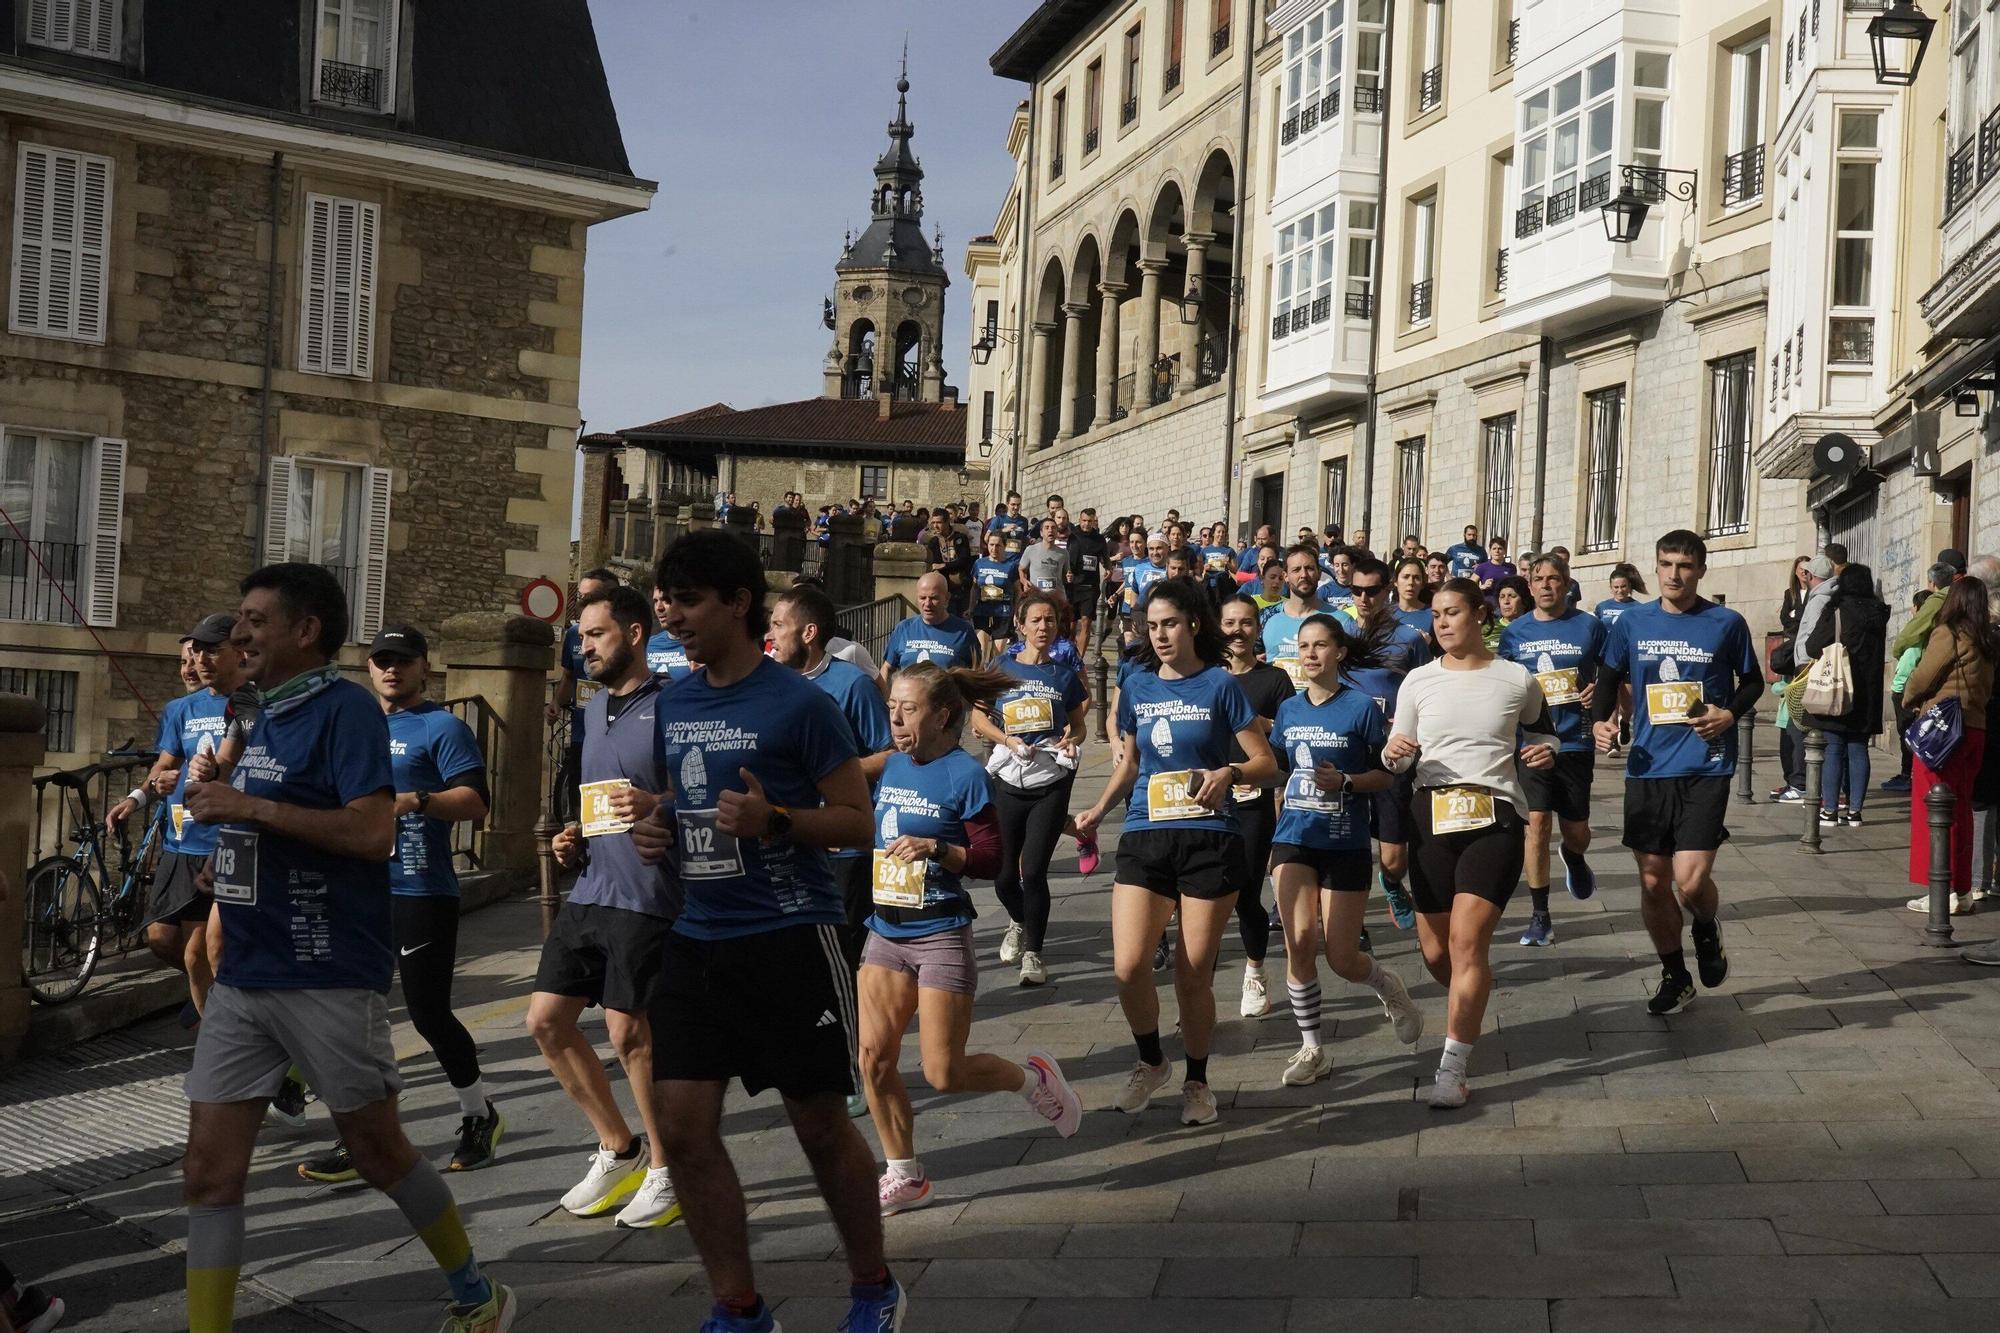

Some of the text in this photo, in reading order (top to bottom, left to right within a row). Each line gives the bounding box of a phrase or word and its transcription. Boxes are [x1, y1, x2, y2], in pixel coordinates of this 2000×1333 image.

[1942, 494, 1948, 504] 2
[1527, 643, 1574, 653] ALMENDRA
[1647, 647, 1704, 656] ALMENDRA
[1676, 655, 1712, 663] KONKISTA
[1545, 678, 1568, 692] 326
[1140, 700, 1184, 710] CONQUISTA
[1662, 692, 1687, 708] 672
[1016, 705, 1040, 720] 640
[1144, 704, 1198, 718] ALMENDRA
[1170, 713, 1211, 722] KONKISTA
[190, 720, 226, 732] ALMEND
[672, 720, 726, 732] CONQUISTA
[672, 728, 742, 744] ALMENDRA
[1286, 732, 1338, 740] ALMENDRA
[705, 740, 757, 752] KONKISTA
[1310, 740, 1348, 748] KONKISTA
[1448, 796, 1476, 814] 237
[900, 806, 940, 818] KONKISTA
[685, 827, 714, 854] 812
[880, 863, 907, 886] 524
